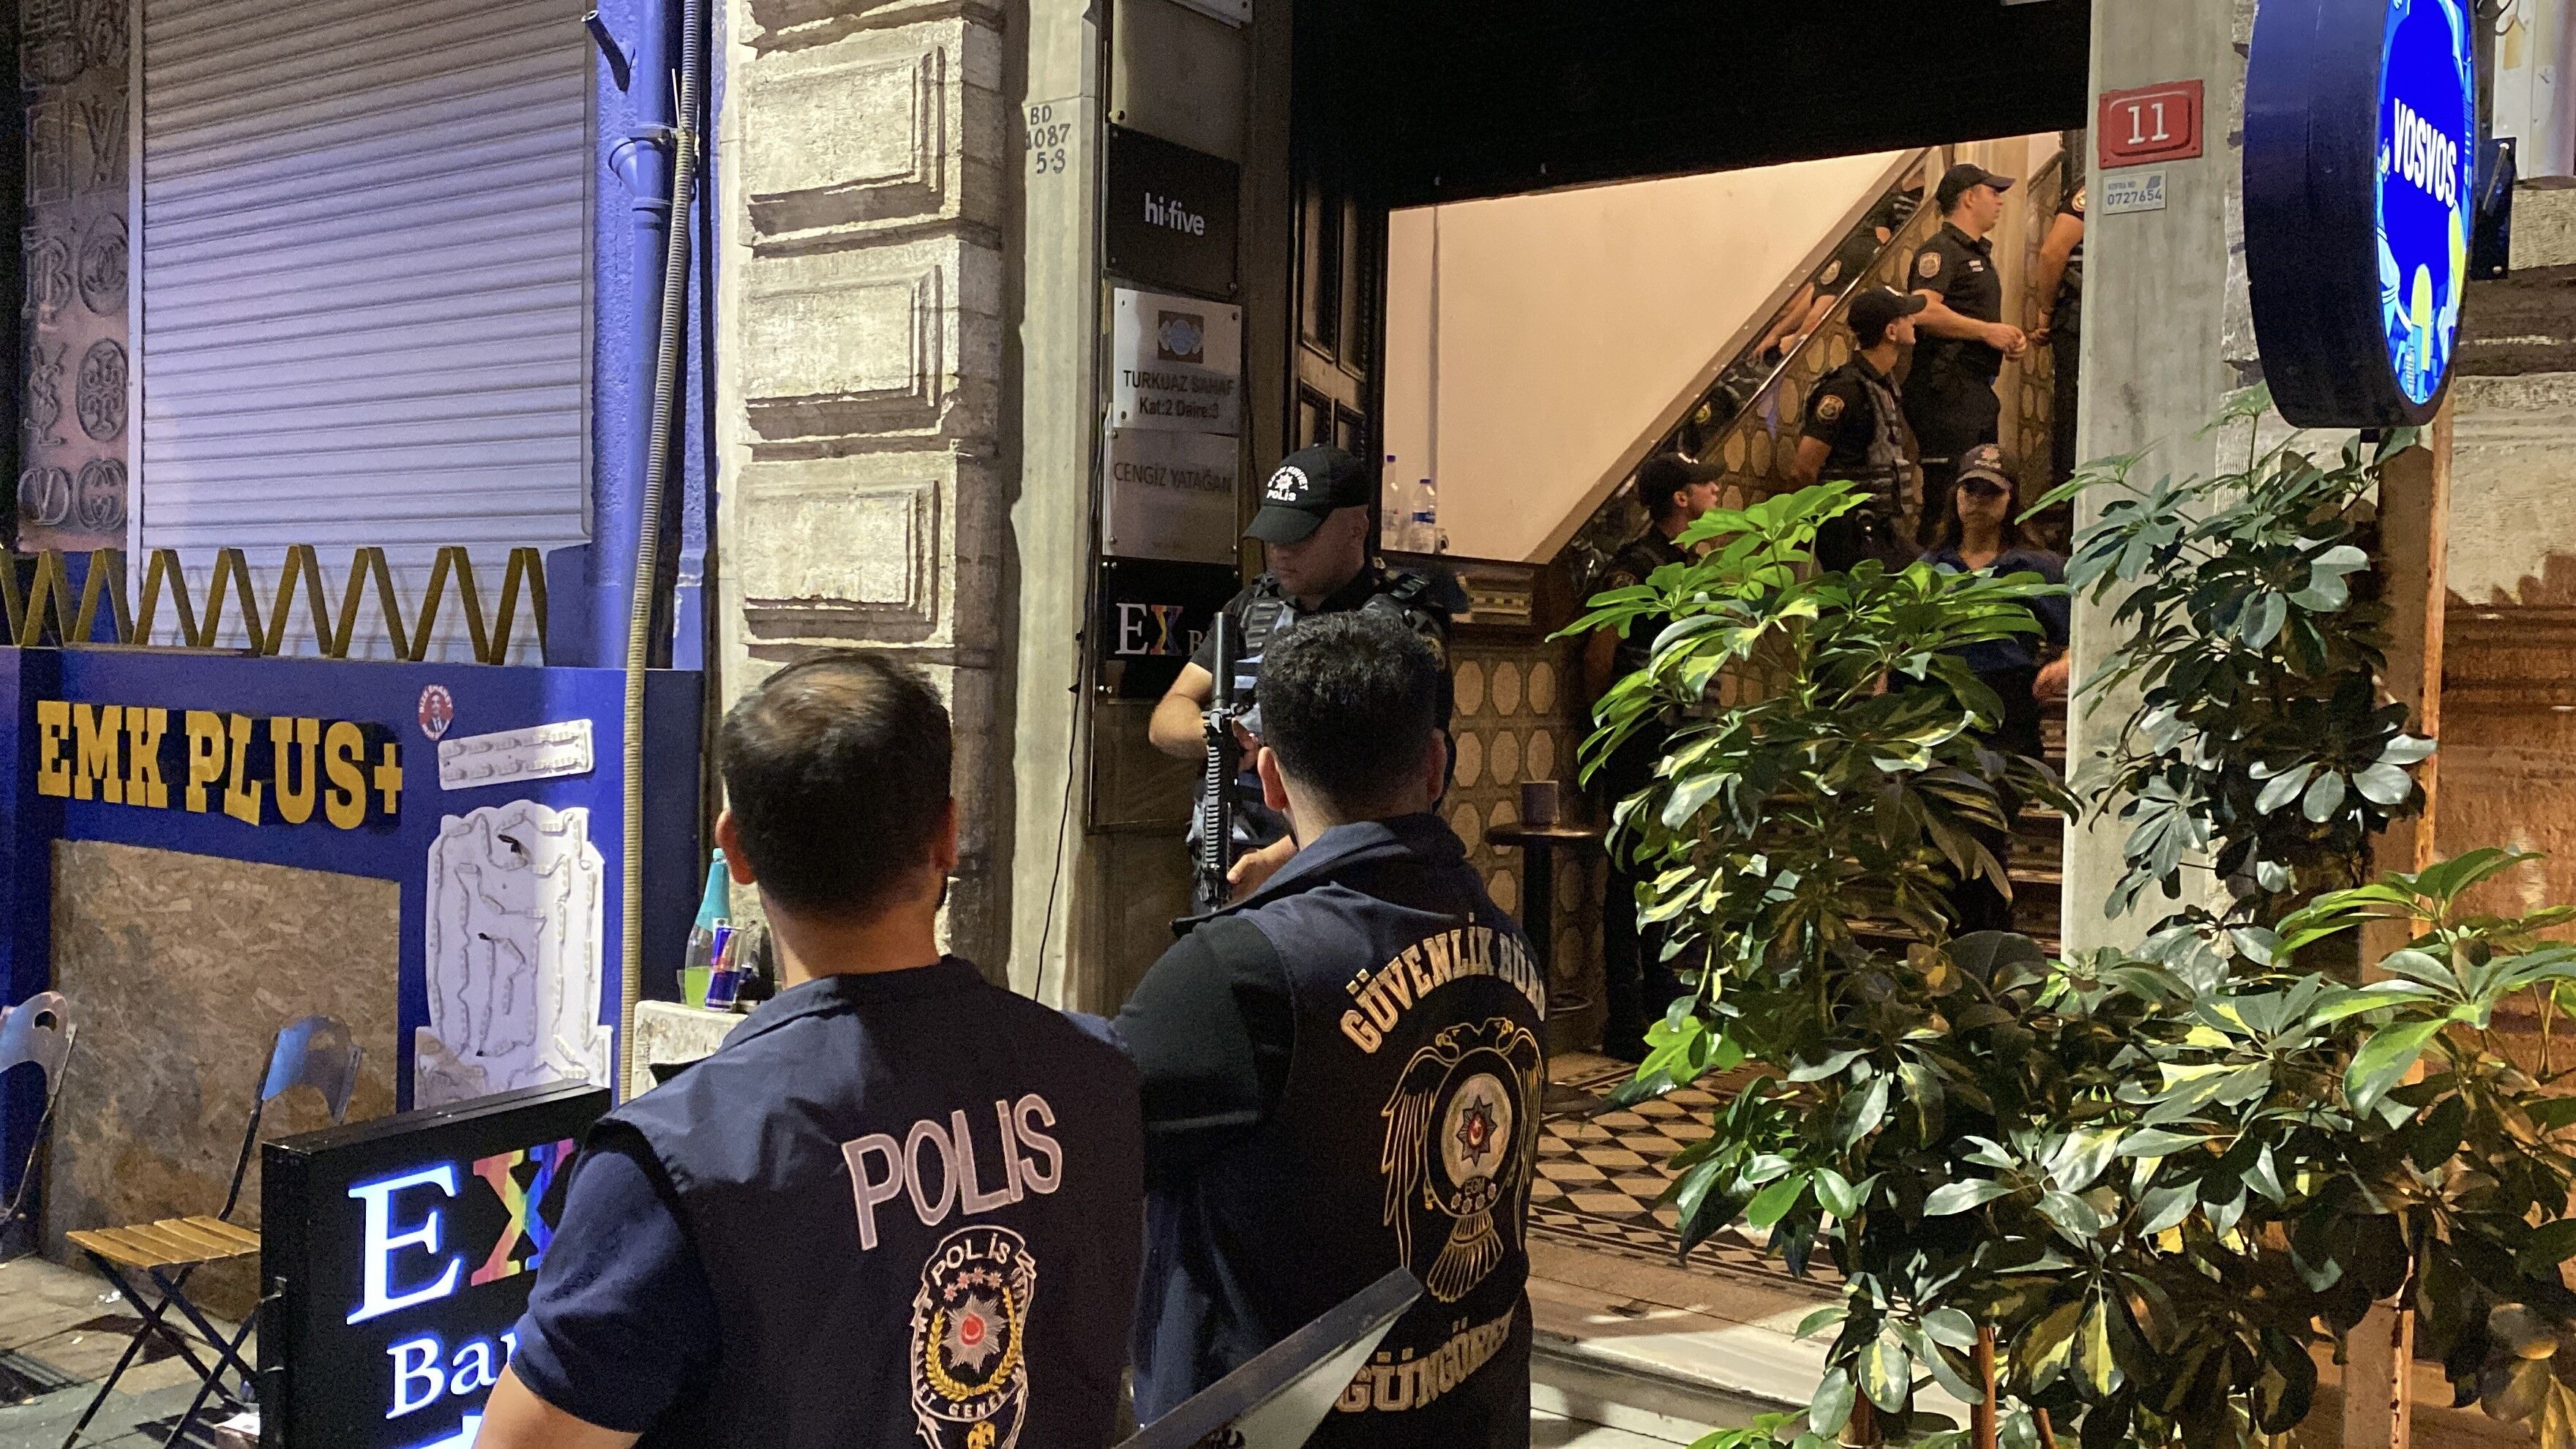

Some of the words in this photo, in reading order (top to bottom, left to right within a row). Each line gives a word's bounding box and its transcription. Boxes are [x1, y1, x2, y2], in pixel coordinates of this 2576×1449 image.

[1030, 105, 1052, 125] BD
[2127, 102, 2170, 145] 11
[2395, 97, 2457, 208] VOSVOS
[2108, 188, 2163, 206] 0727654
[37, 700, 168, 809] EMK
[185, 710, 402, 830] PLUS+
[1340, 912, 1494, 1054] GÜVENLİK
[346, 1137, 575, 1325] EX
